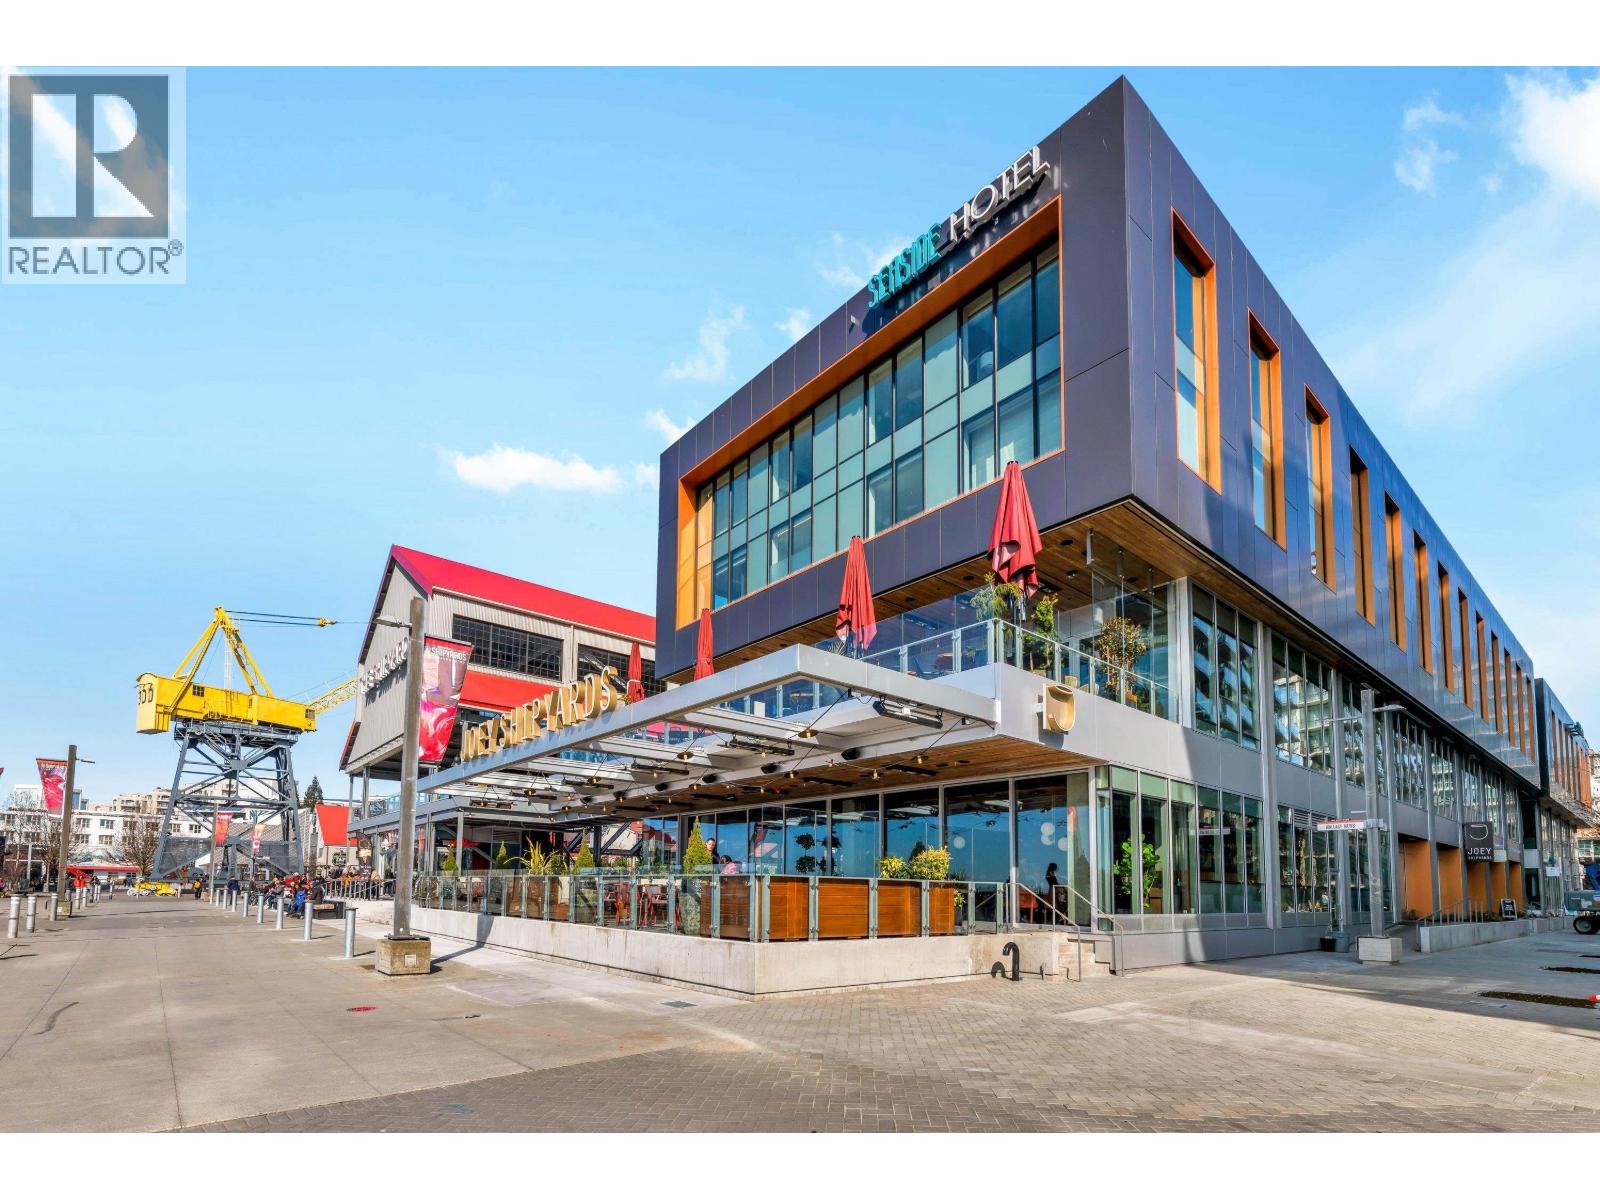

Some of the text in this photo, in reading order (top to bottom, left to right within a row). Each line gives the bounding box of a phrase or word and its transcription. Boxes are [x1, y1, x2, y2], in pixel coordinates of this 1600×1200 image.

[868, 145, 1051, 308] SEASIDE HOTEL
[461, 665, 618, 762] JOEY SHIPYARDS
[1467, 847, 1492, 855] JOEY
